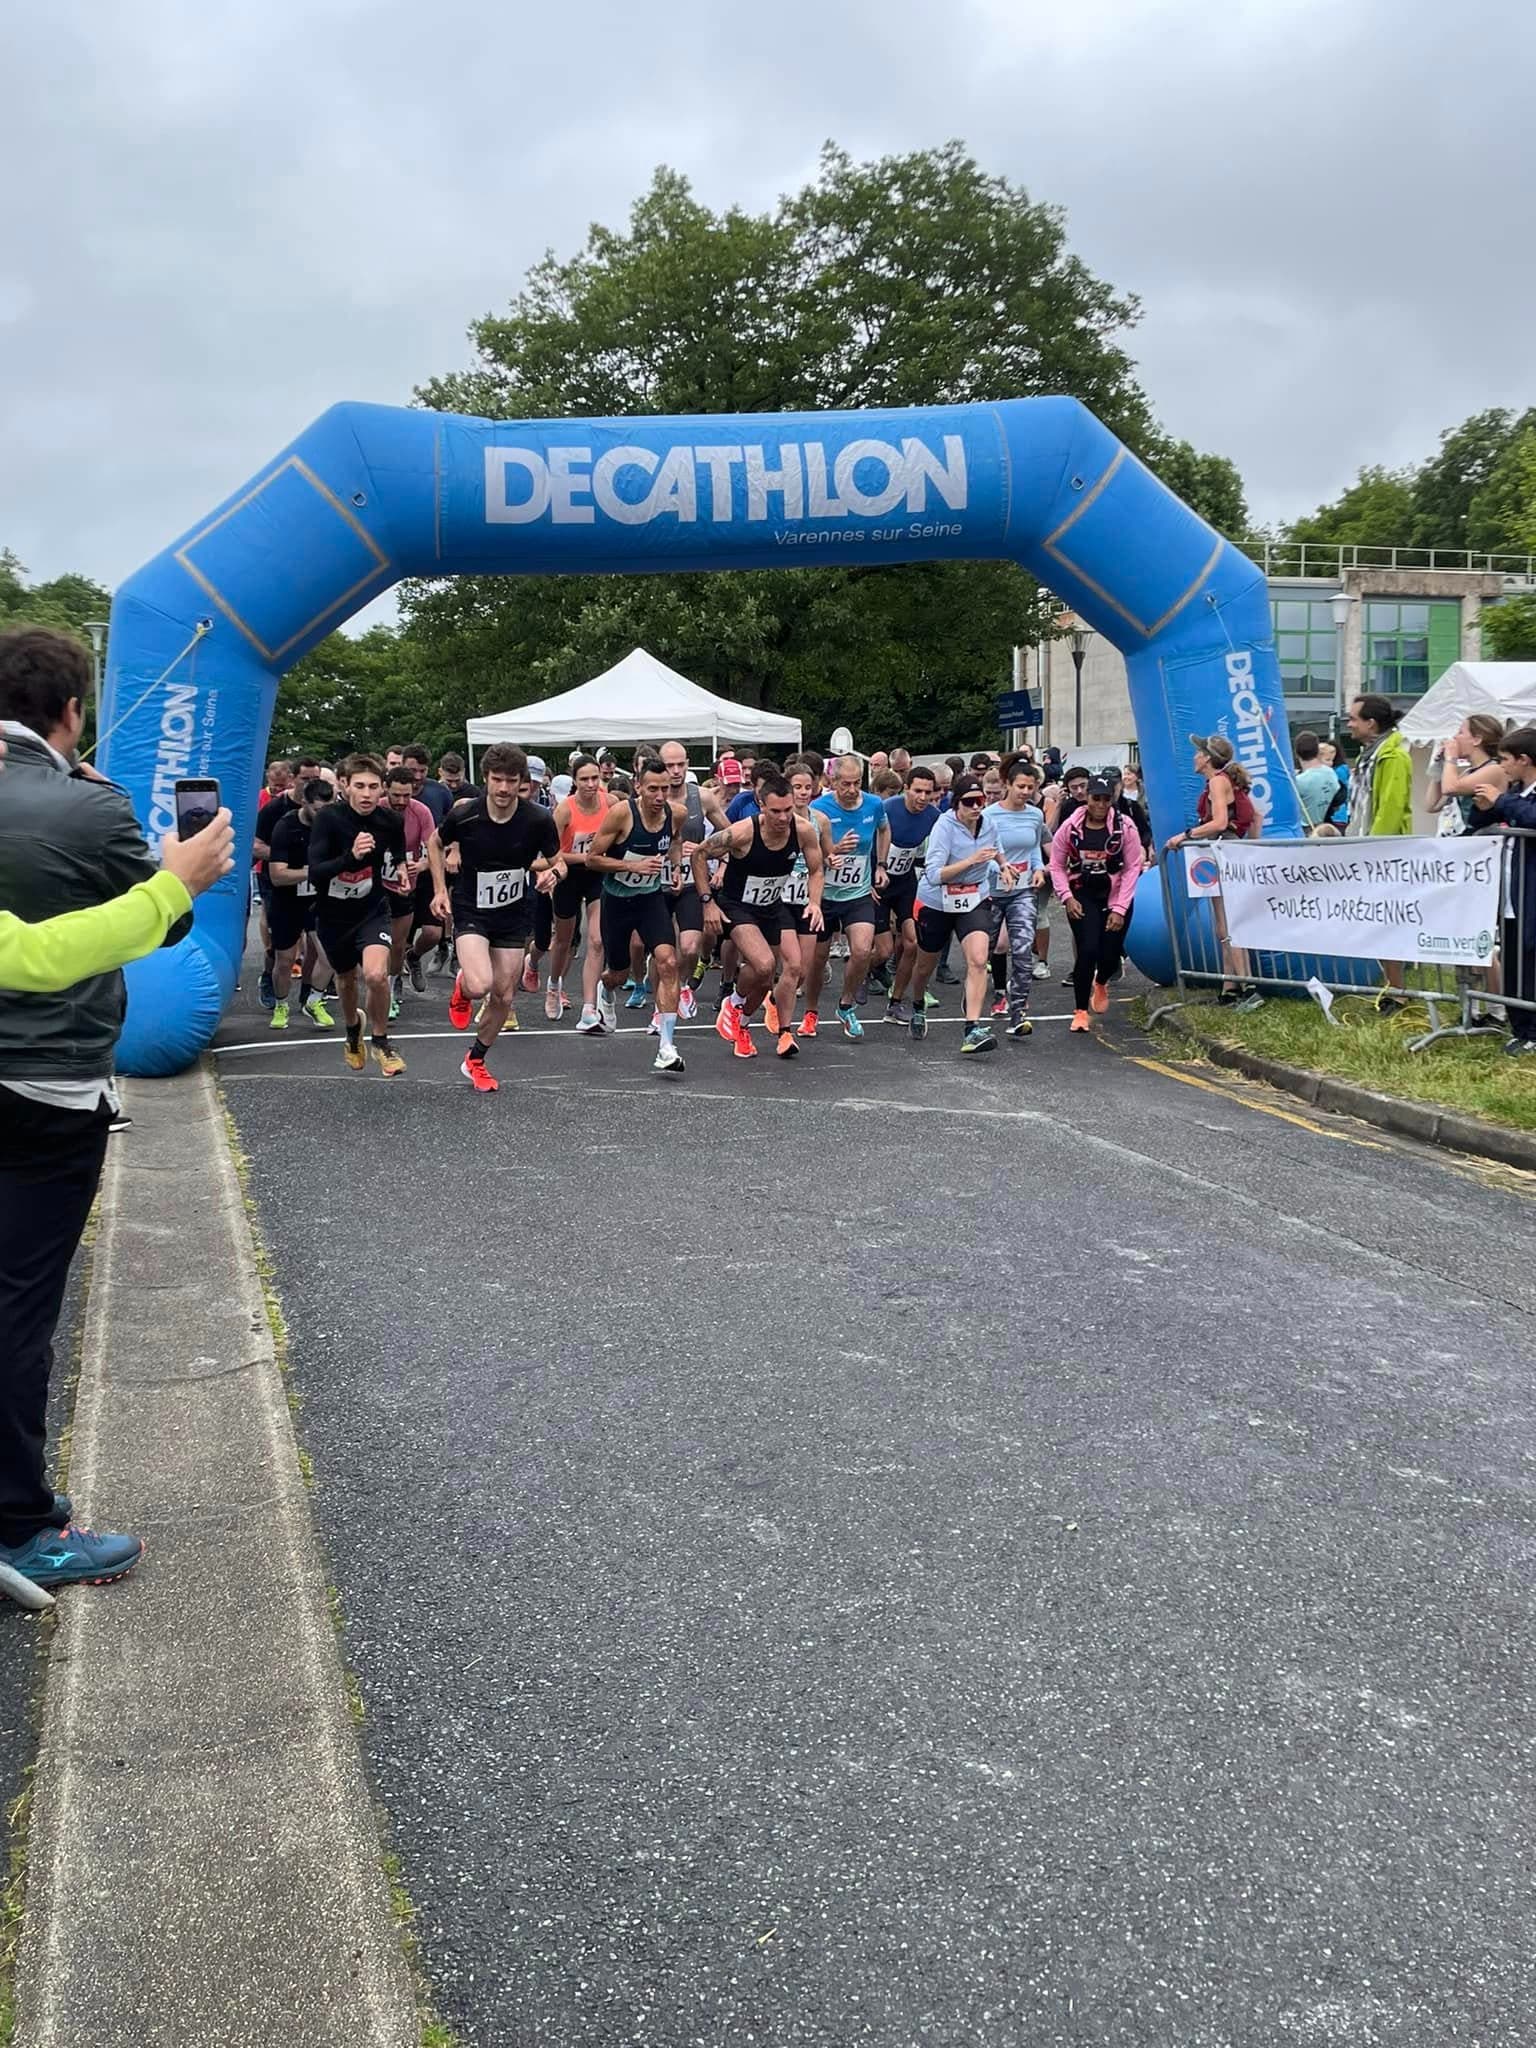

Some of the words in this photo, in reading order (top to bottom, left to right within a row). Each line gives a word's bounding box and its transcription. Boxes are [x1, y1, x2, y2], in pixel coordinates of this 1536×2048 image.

[484, 434, 967, 525] DECATHLON
[775, 529, 865, 545] Varennes
[872, 528, 903, 541] sur
[909, 523, 962, 538] Seine
[146, 683, 198, 862] CATHLON
[832, 867, 861, 884] 156
[1249, 864, 1278, 885] VERT
[1364, 858, 1456, 885] PARTENAIRE
[1463, 857, 1492, 884] DES
[485, 881, 520, 905] 160
[751, 886, 781, 904] 120
[954, 898, 969, 910] 54
[1417, 932, 1450, 949] Gamm
